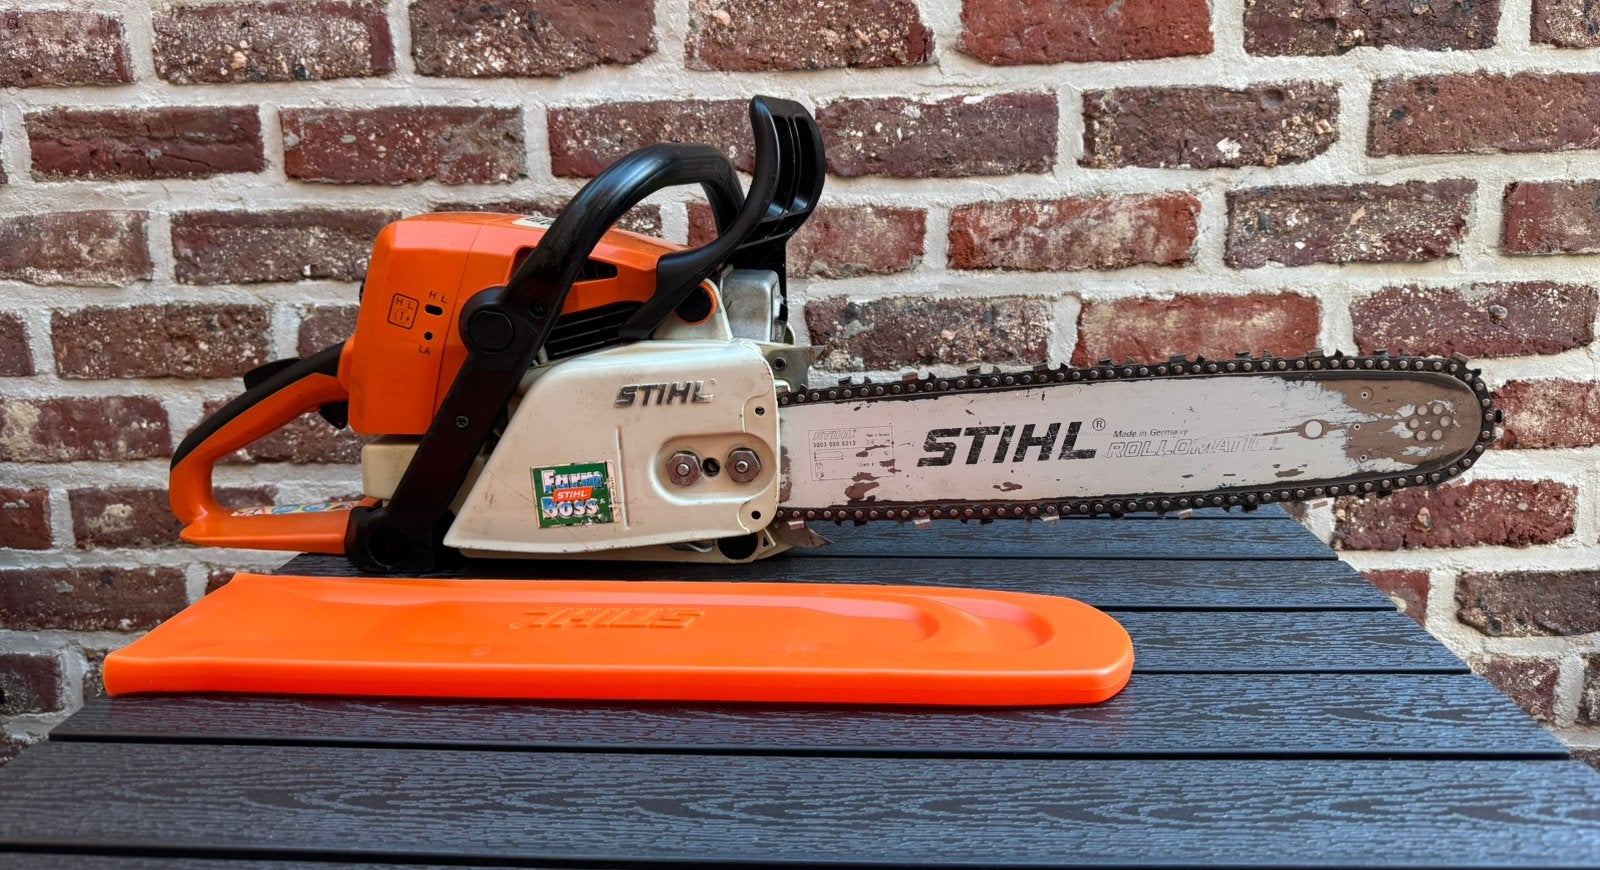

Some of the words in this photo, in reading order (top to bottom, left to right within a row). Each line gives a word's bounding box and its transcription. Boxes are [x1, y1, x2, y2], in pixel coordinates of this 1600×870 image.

[428, 290, 438, 300] H
[440, 295, 447, 304] L
[418, 344, 430, 356] LA
[613, 380, 714, 408] STIHL
[812, 429, 856, 441] STIHL
[1112, 429, 1137, 439] Made
[1138, 429, 1147, 438] in
[1149, 428, 1189, 438] Germany
[916, 421, 1098, 467] STIHL
[557, 489, 588, 500] STIHL
[524, 606, 705, 629] STIHL
